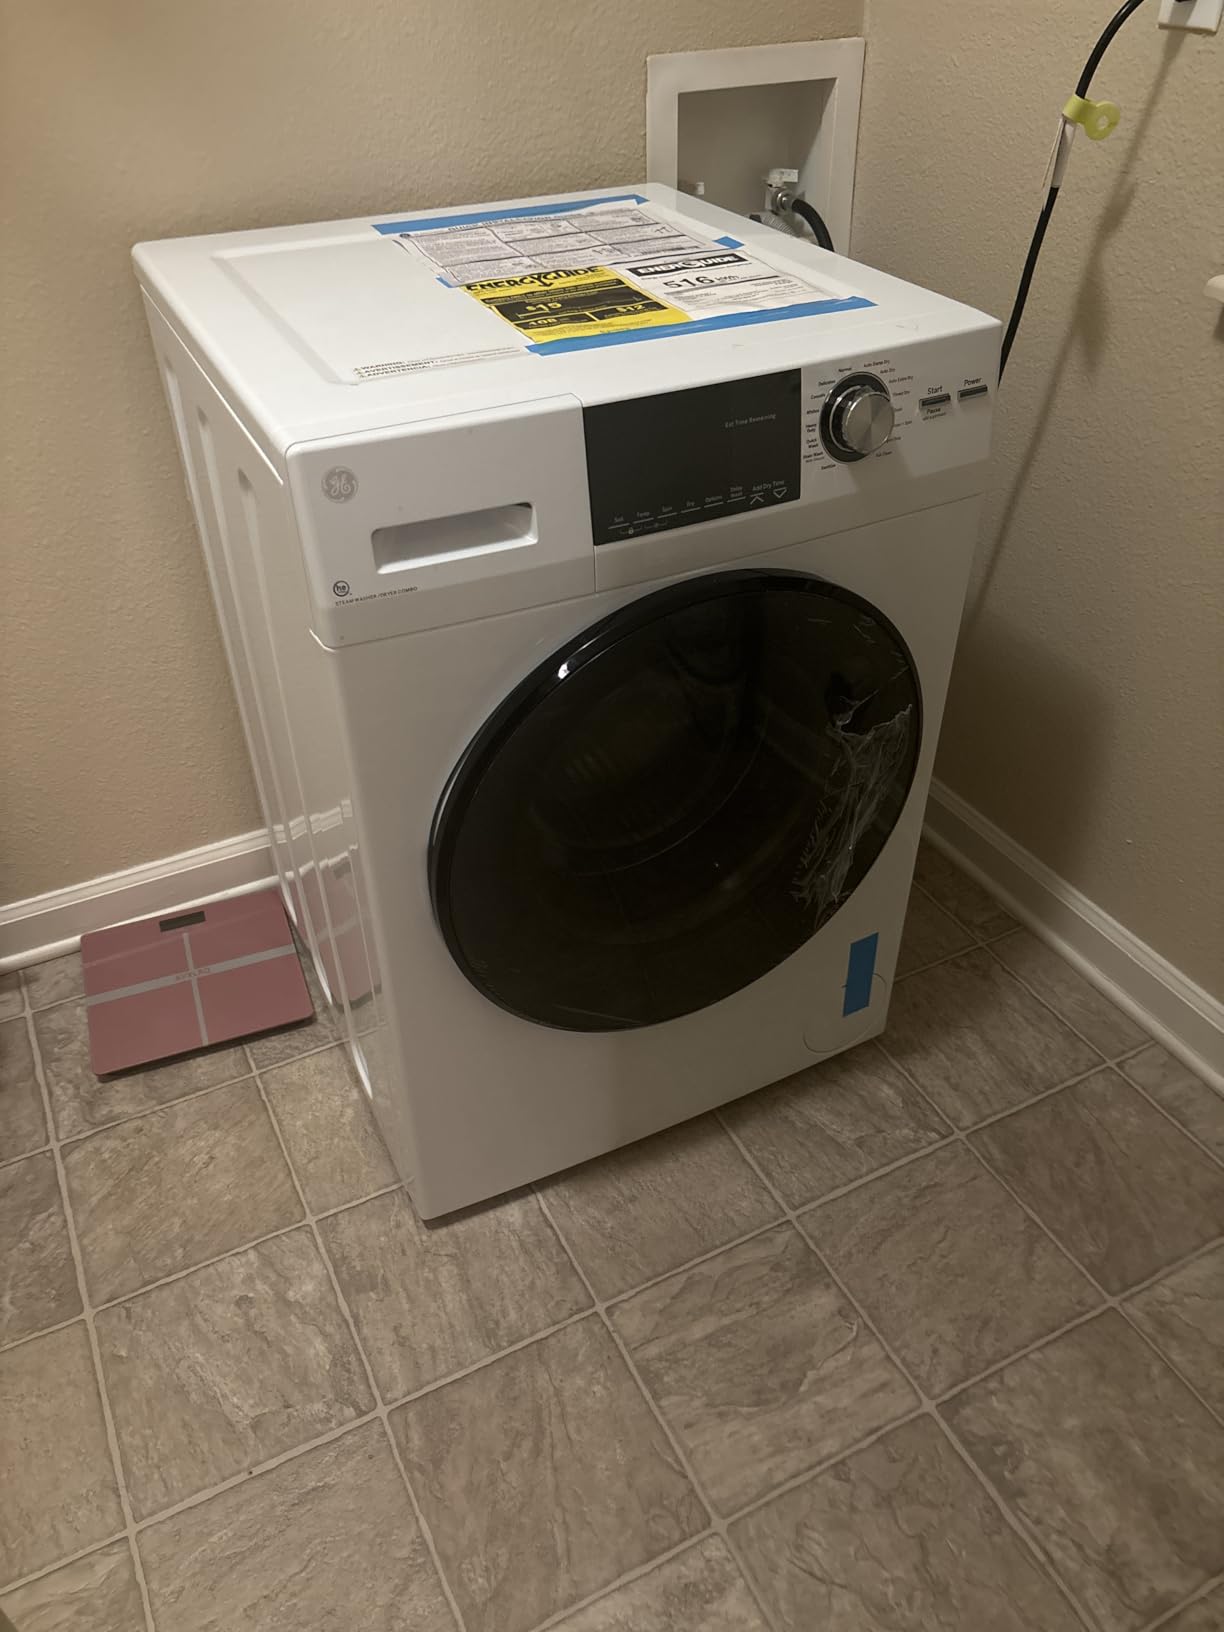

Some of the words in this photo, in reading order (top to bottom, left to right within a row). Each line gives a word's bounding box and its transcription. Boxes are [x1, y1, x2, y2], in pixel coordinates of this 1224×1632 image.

[664, 275, 714, 290] 516
[964, 377, 982, 386] Power
[928, 386, 943, 395] Start
[398, 586, 418, 594] COMBO
